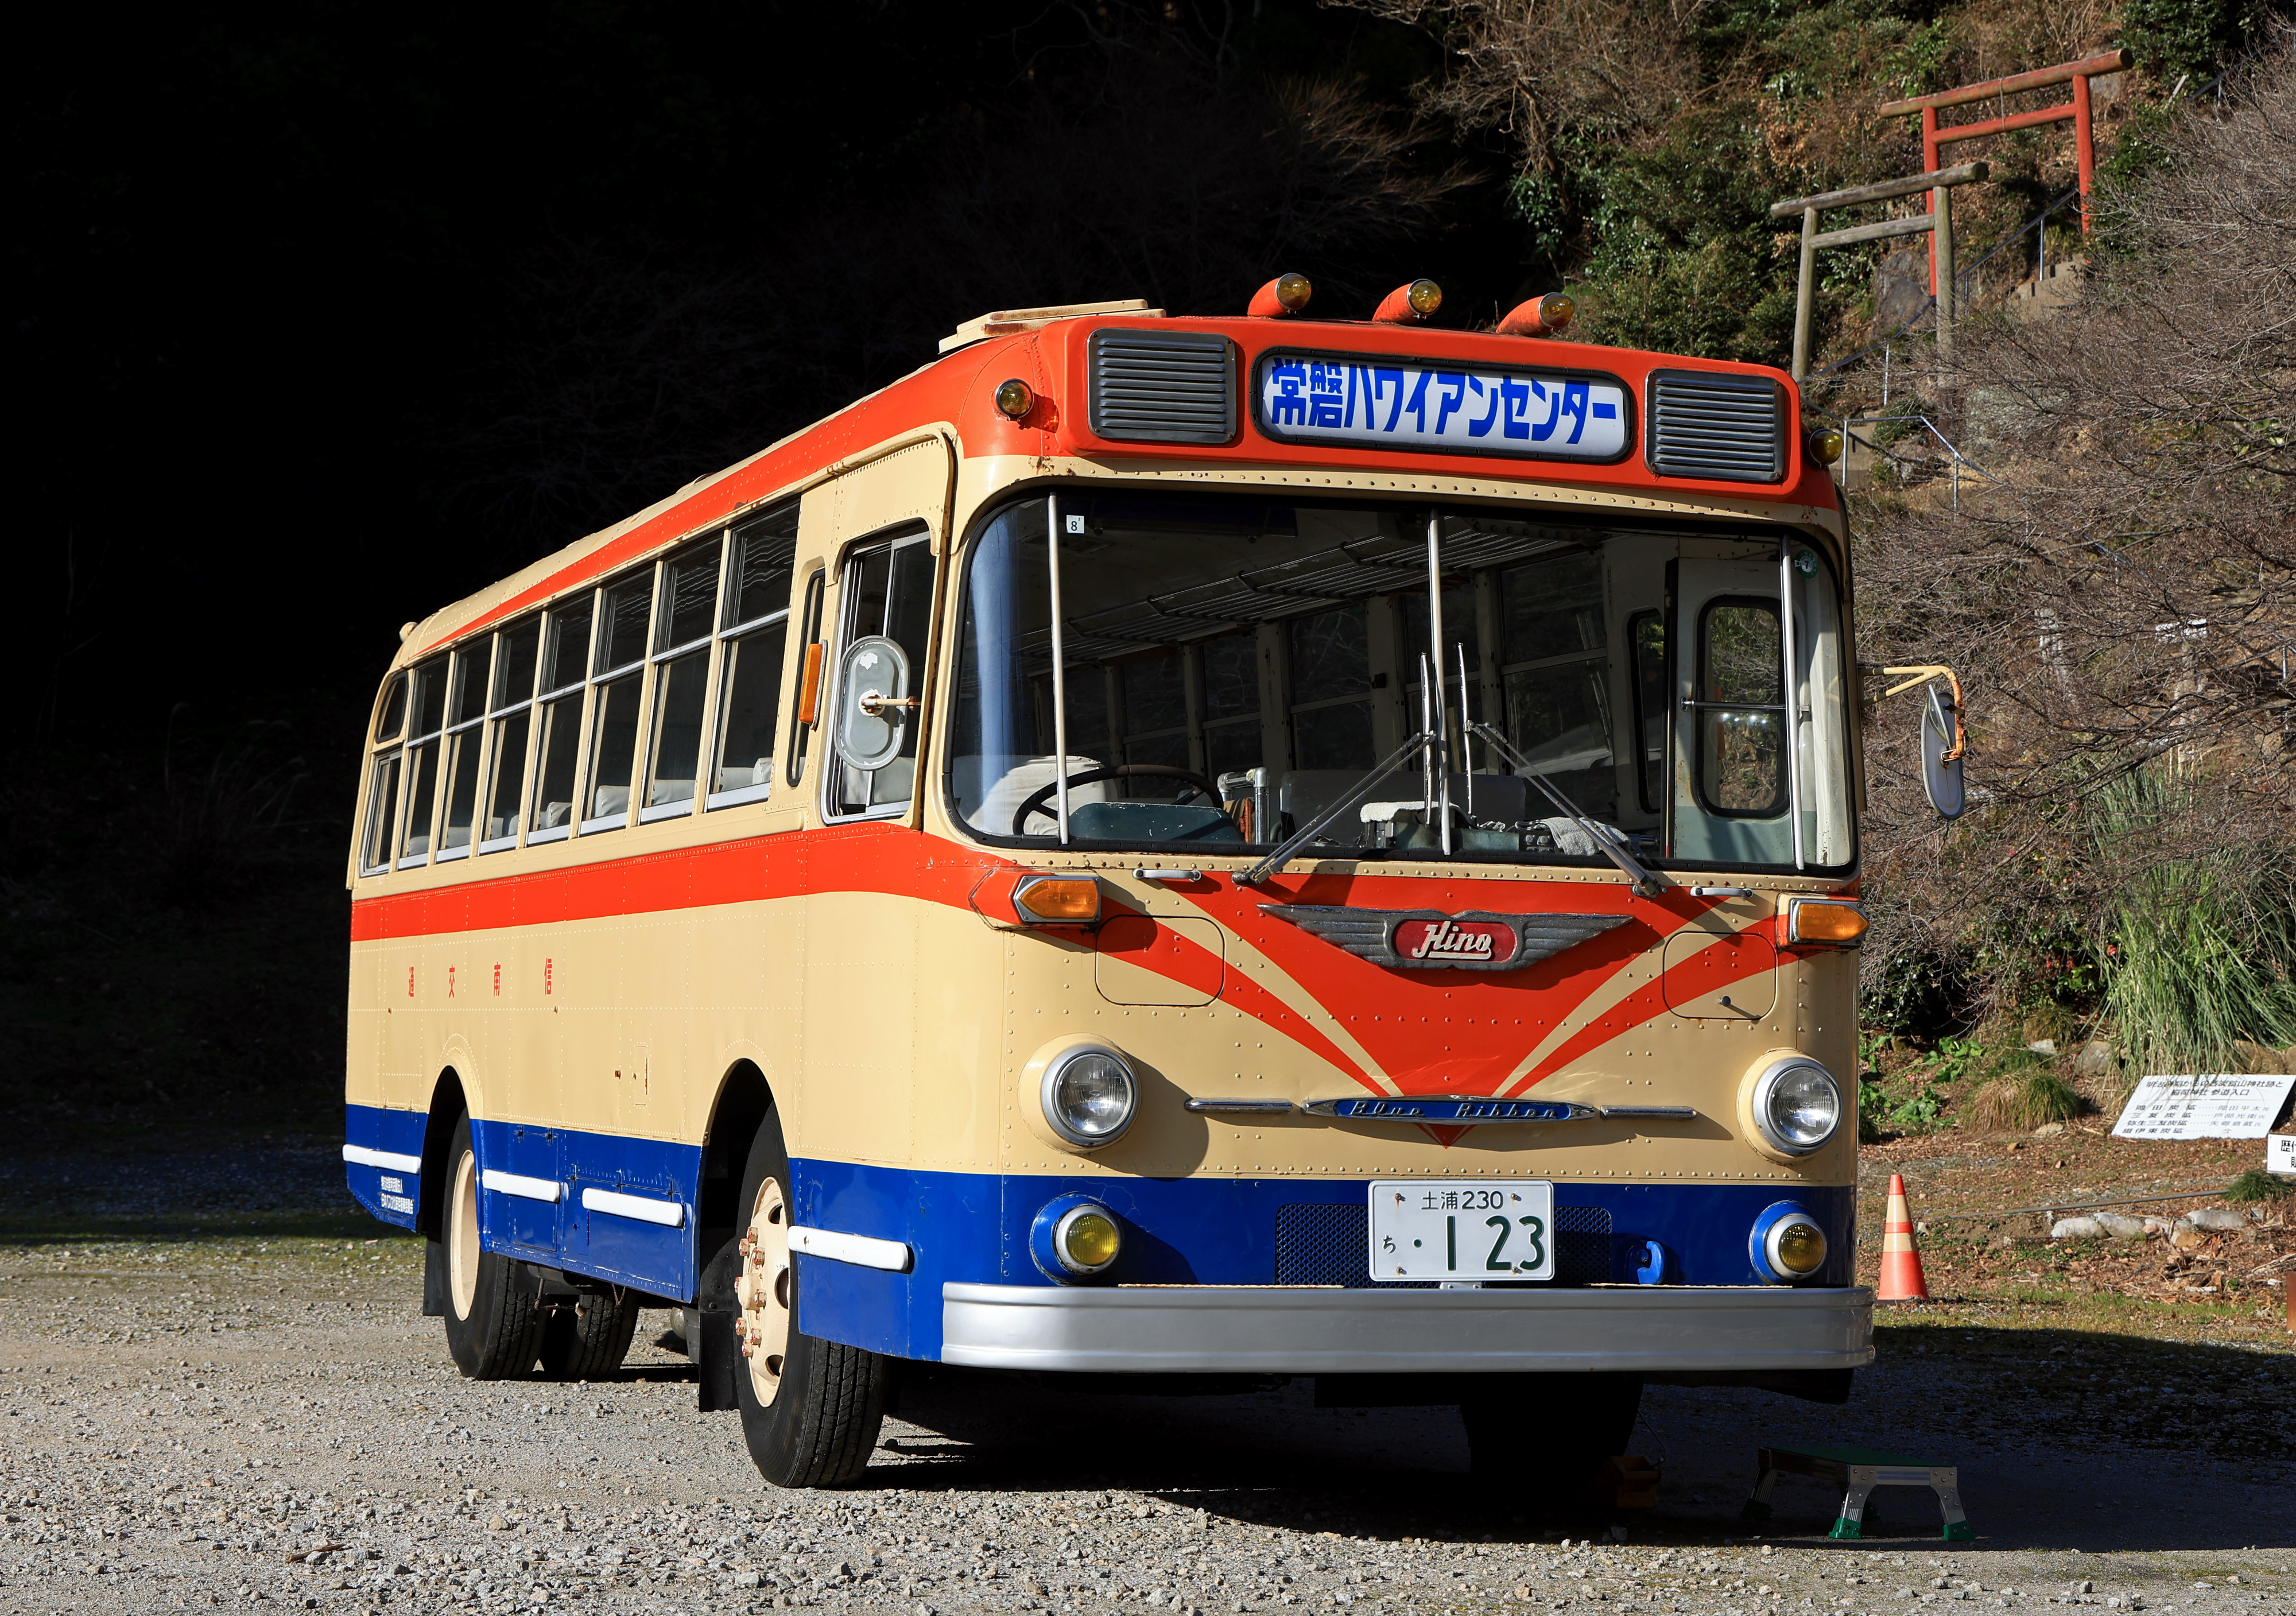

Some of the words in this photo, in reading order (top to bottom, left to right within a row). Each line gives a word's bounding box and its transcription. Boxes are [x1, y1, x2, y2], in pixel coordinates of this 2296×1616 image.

[1271, 356, 1617, 445] 常磐ハワイアンセンター
[1071, 521, 1077, 531] 8
[1804, 560, 1809, 569] 7
[1411, 920, 1492, 960] Hino
[1349, 1101, 1426, 1117] Blue
[1454, 1103, 1558, 1119] Ribbon
